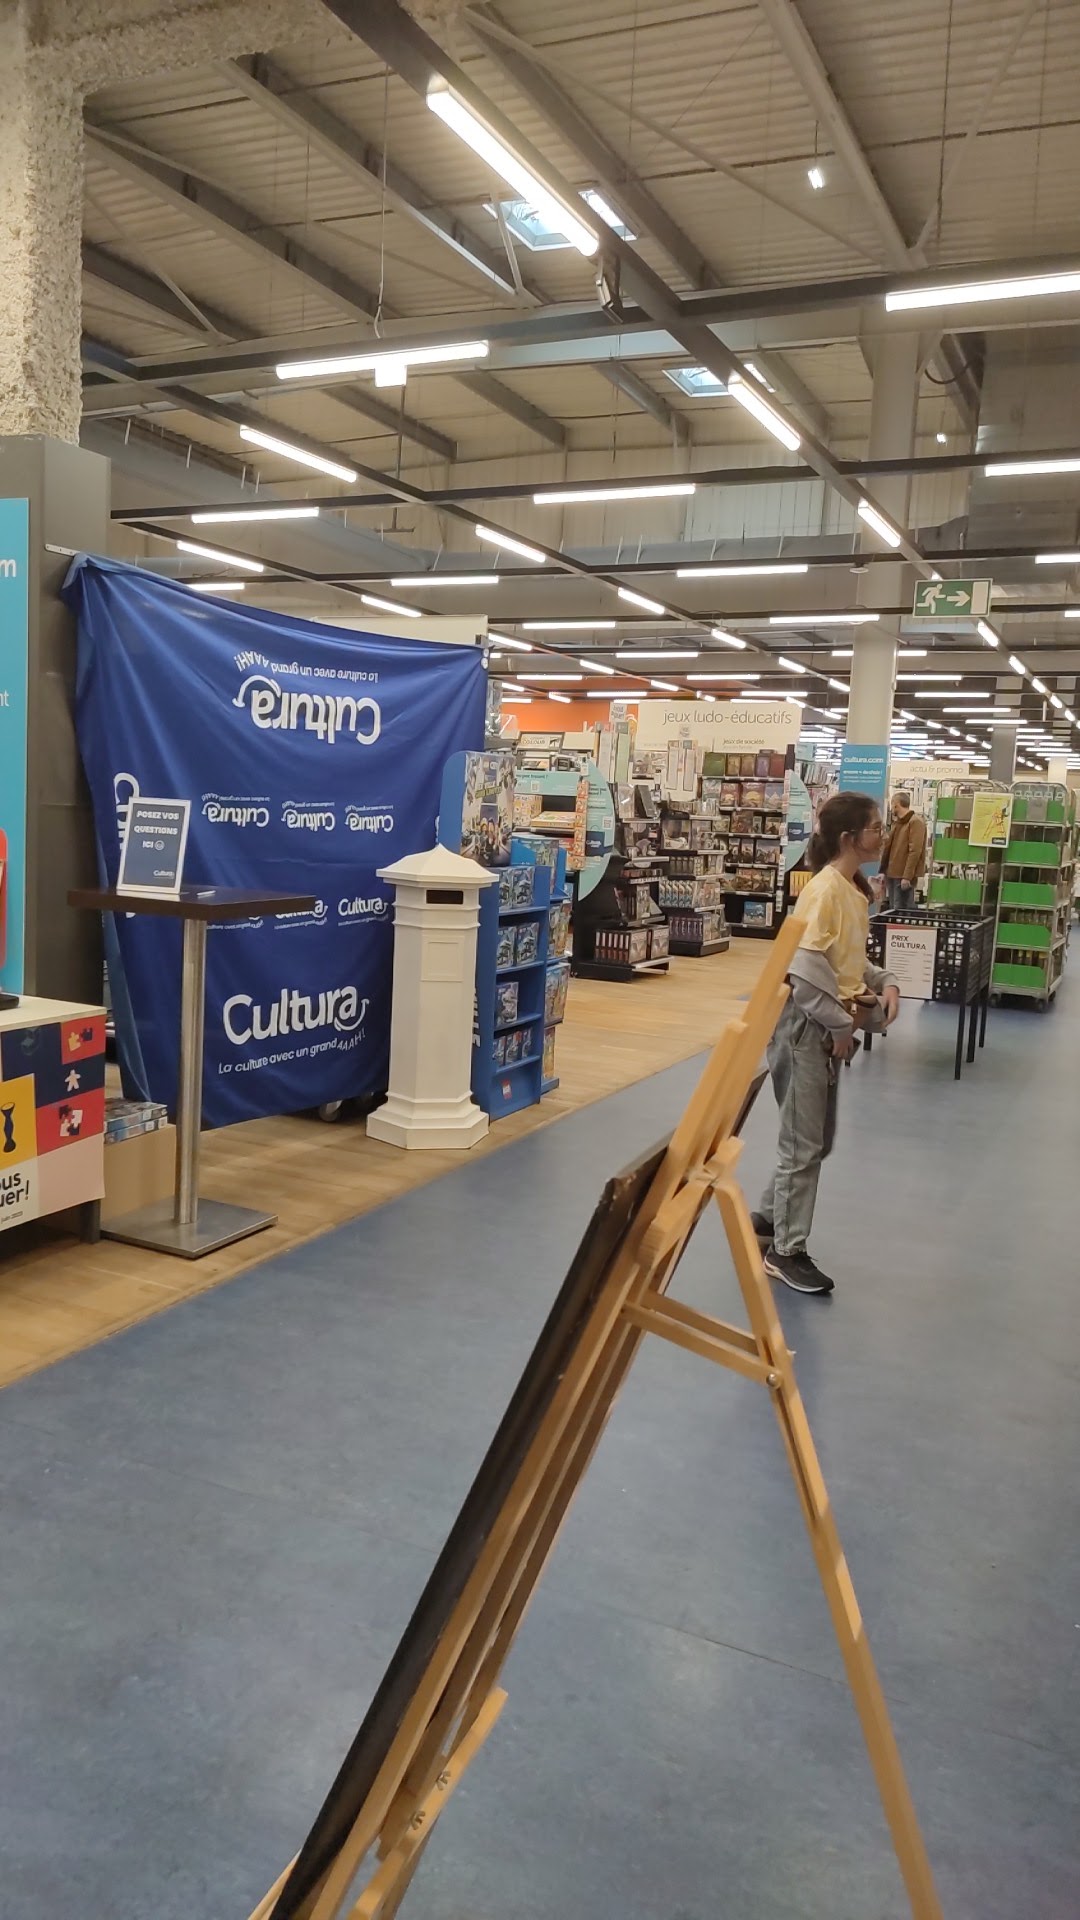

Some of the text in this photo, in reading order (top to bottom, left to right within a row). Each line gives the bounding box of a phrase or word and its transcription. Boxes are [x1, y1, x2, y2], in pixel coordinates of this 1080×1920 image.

[271, 661, 299, 675] grand
[300, 666, 313, 676] un
[314, 668, 337, 679] avec
[337, 669, 367, 683] culture
[240, 682, 381, 745] Cultura
[662, 709, 793, 725] jeux ludo-éducatifs
[936, 767, 963, 776] promo
[136, 810, 180, 820] POSEZ VOS
[204, 803, 270, 828] Cultura
[284, 810, 336, 831] Cultura
[347, 812, 394, 833] Cultura
[133, 825, 178, 835] QUESTIONS
[142, 840, 154, 848] ICI
[338, 897, 386, 916] Cultura
[891, 934, 909, 942] PRIX
[890, 941, 926, 950] CULTURA
[223, 986, 366, 1045] Cultura
[218, 1062, 233, 1074] La
[234, 1056, 269, 1073] culture
[269, 1050, 295, 1063] avec
[295, 1048, 309, 1058] un
[309, 1037, 337, 1057] grand
